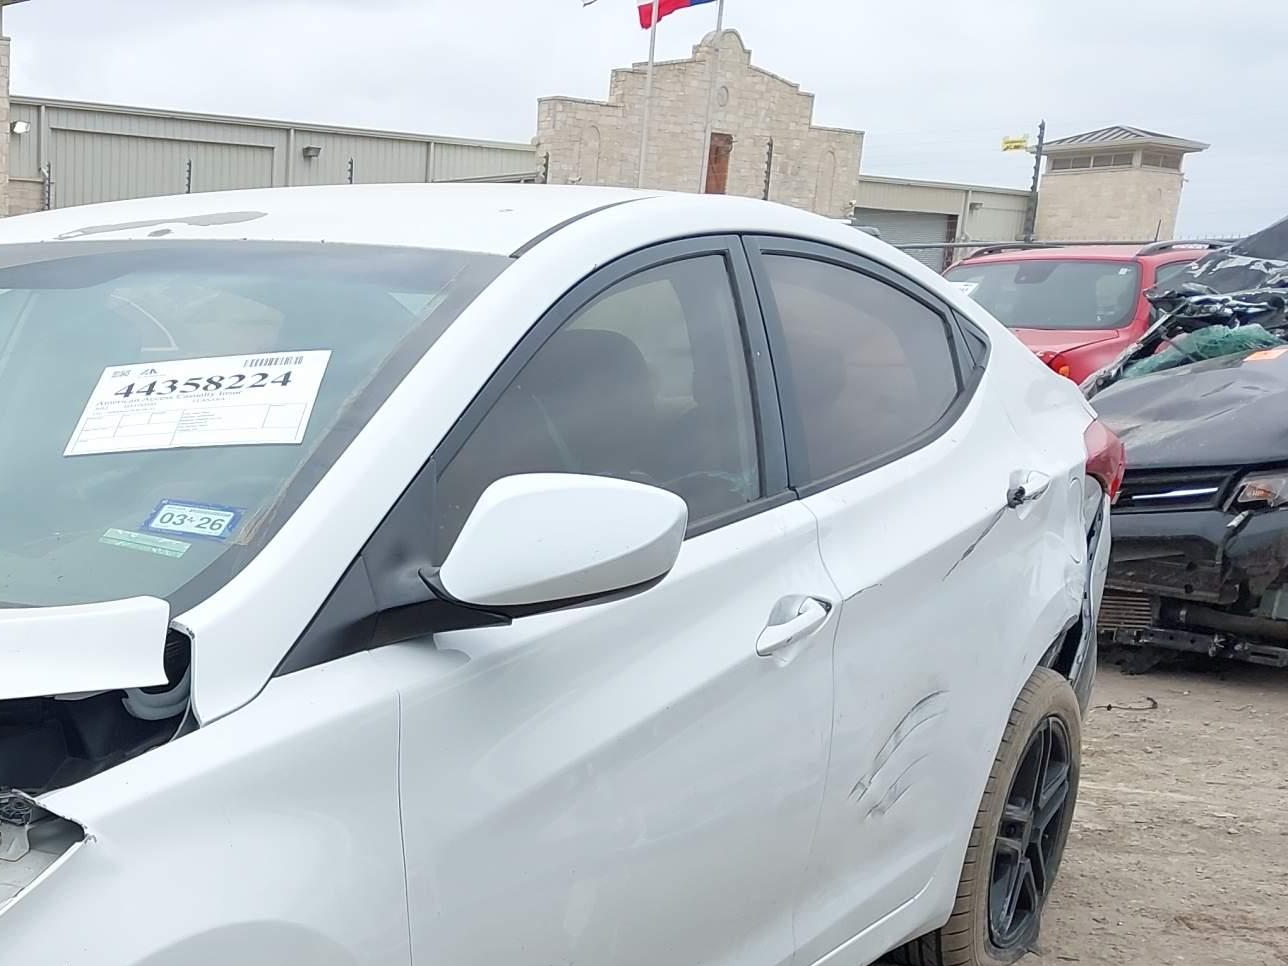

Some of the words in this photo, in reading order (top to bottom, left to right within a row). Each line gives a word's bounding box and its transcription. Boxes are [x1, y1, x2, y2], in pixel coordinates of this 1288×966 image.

[114, 370, 293, 399] 44358224
[159, 512, 188, 526] 03
[194, 516, 225, 531] 26
